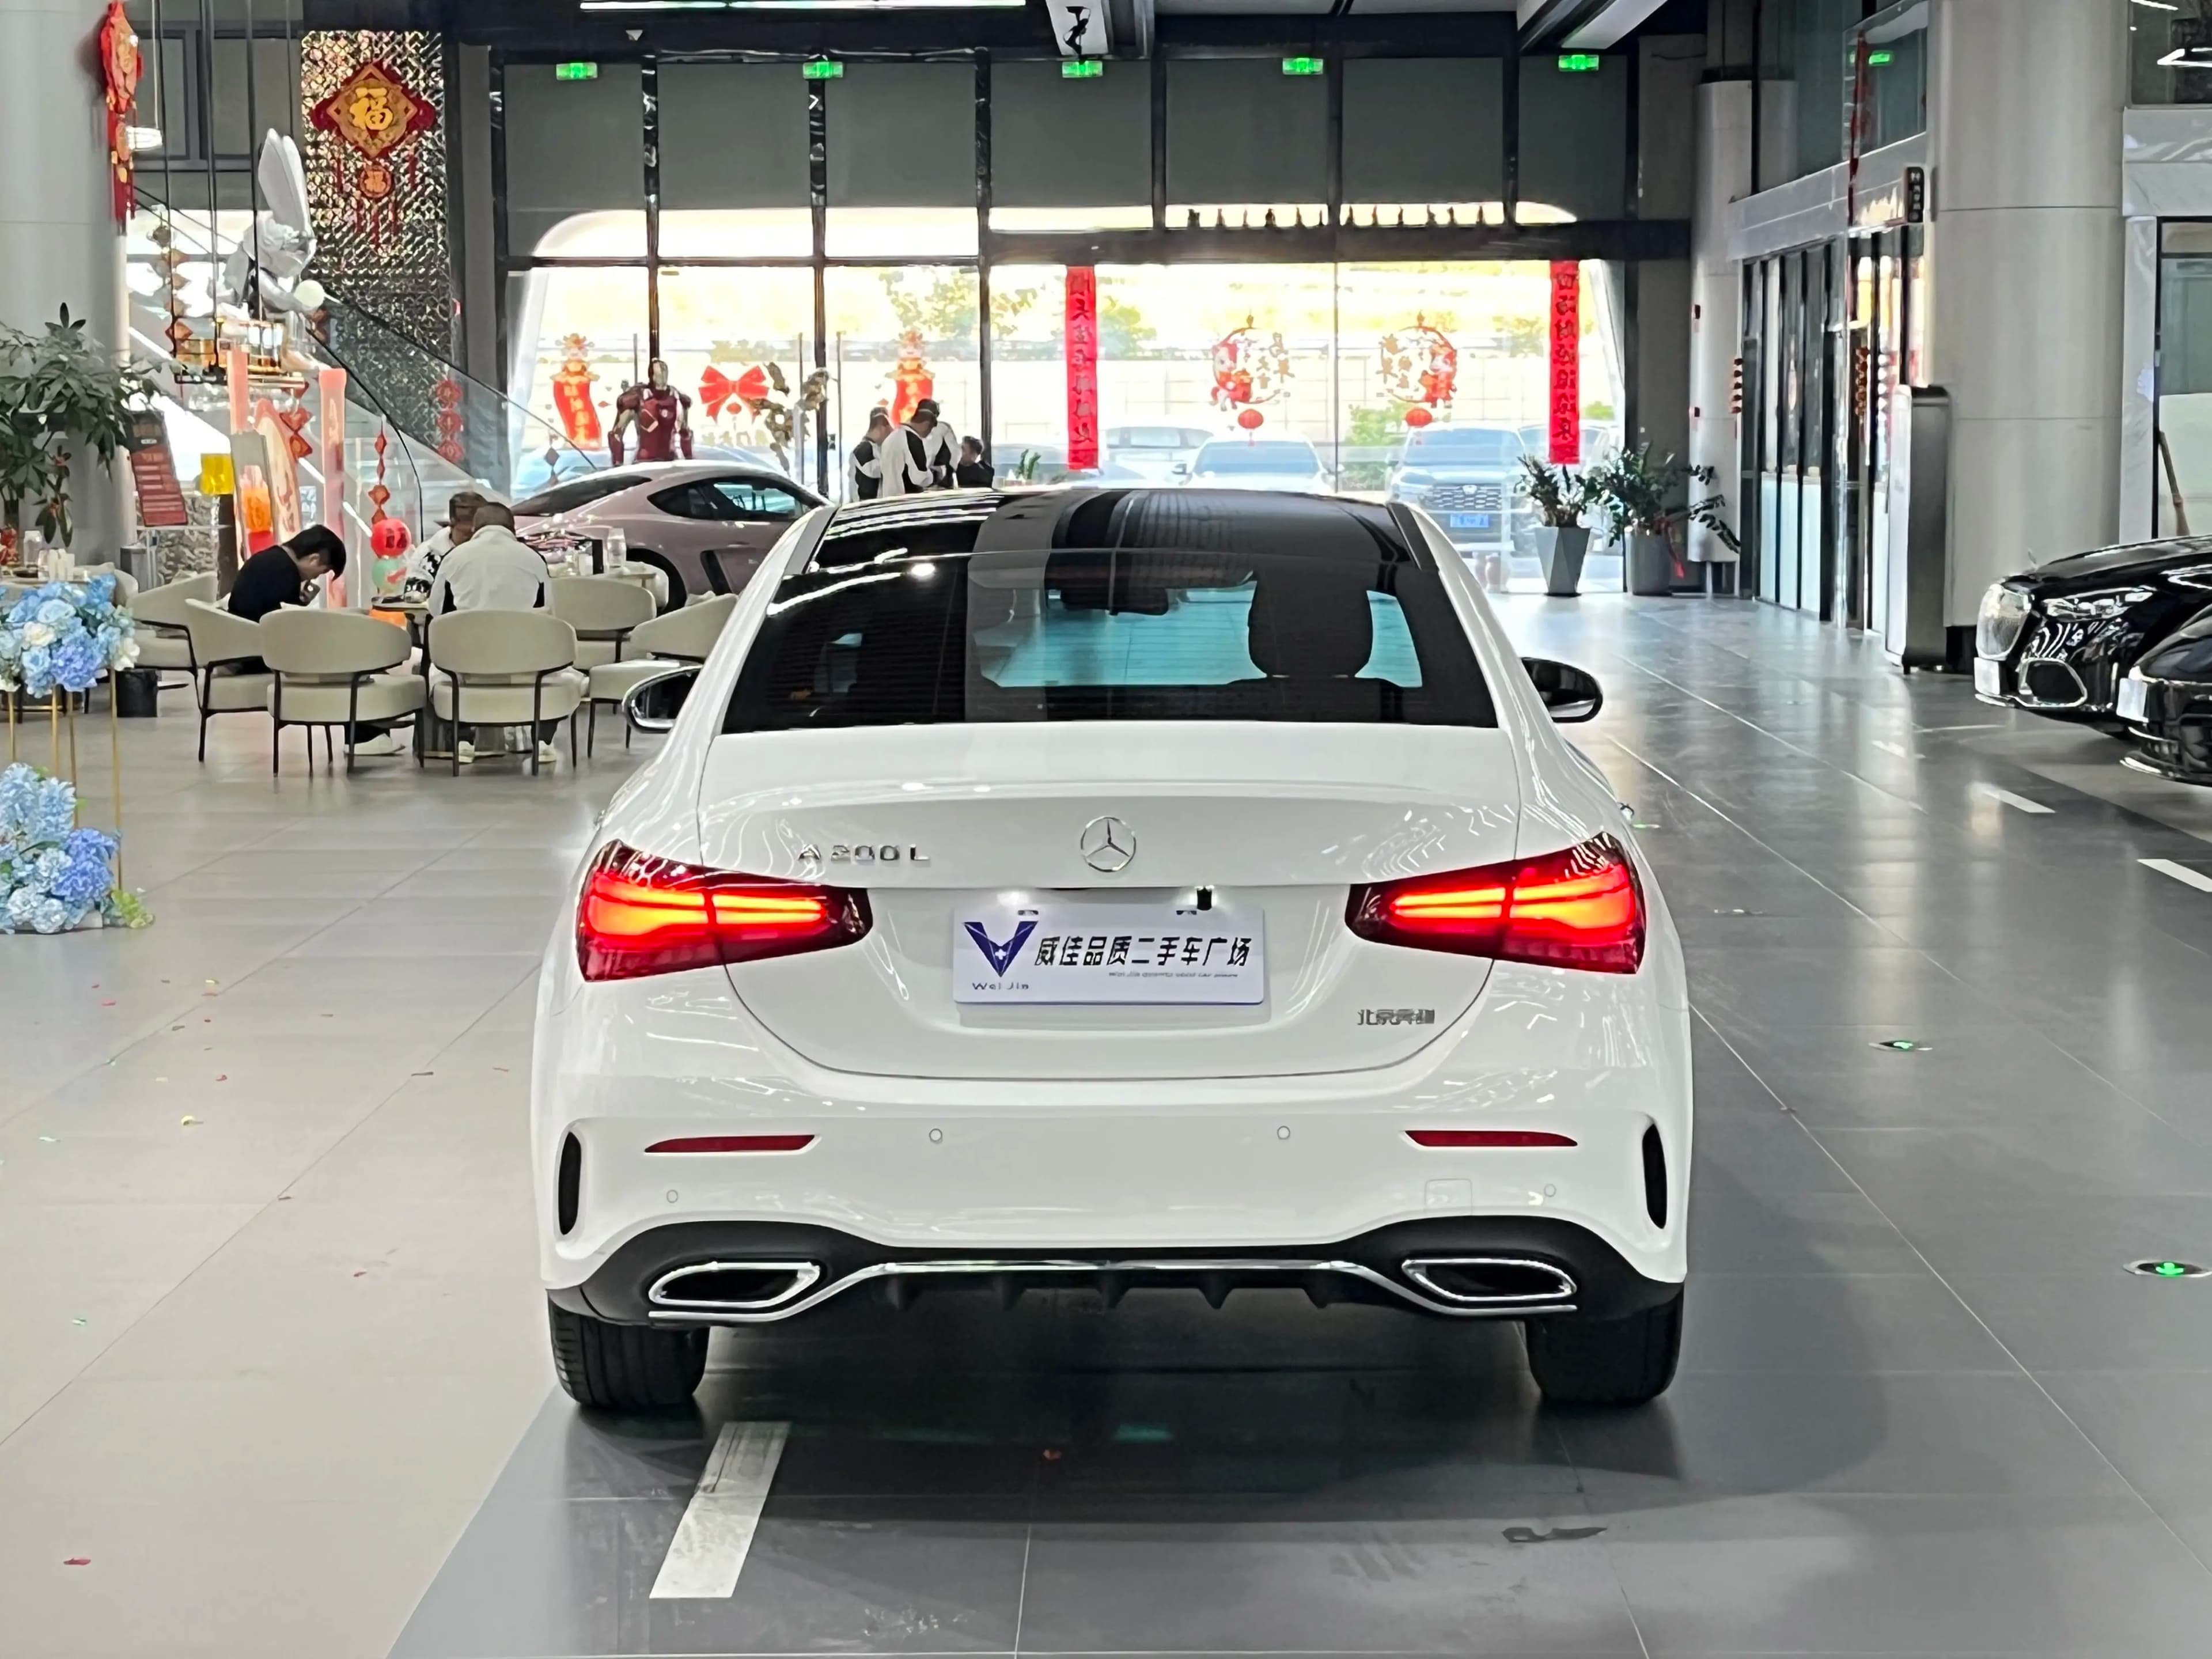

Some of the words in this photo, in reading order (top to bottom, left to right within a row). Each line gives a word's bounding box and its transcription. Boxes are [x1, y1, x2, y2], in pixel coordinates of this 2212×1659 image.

[349, 88, 394, 130] 福
[798, 843, 823, 861] A
[830, 844, 900, 862] 200
[909, 843, 930, 862] L
[1034, 935, 1252, 967] 威佳品质二手车广场
